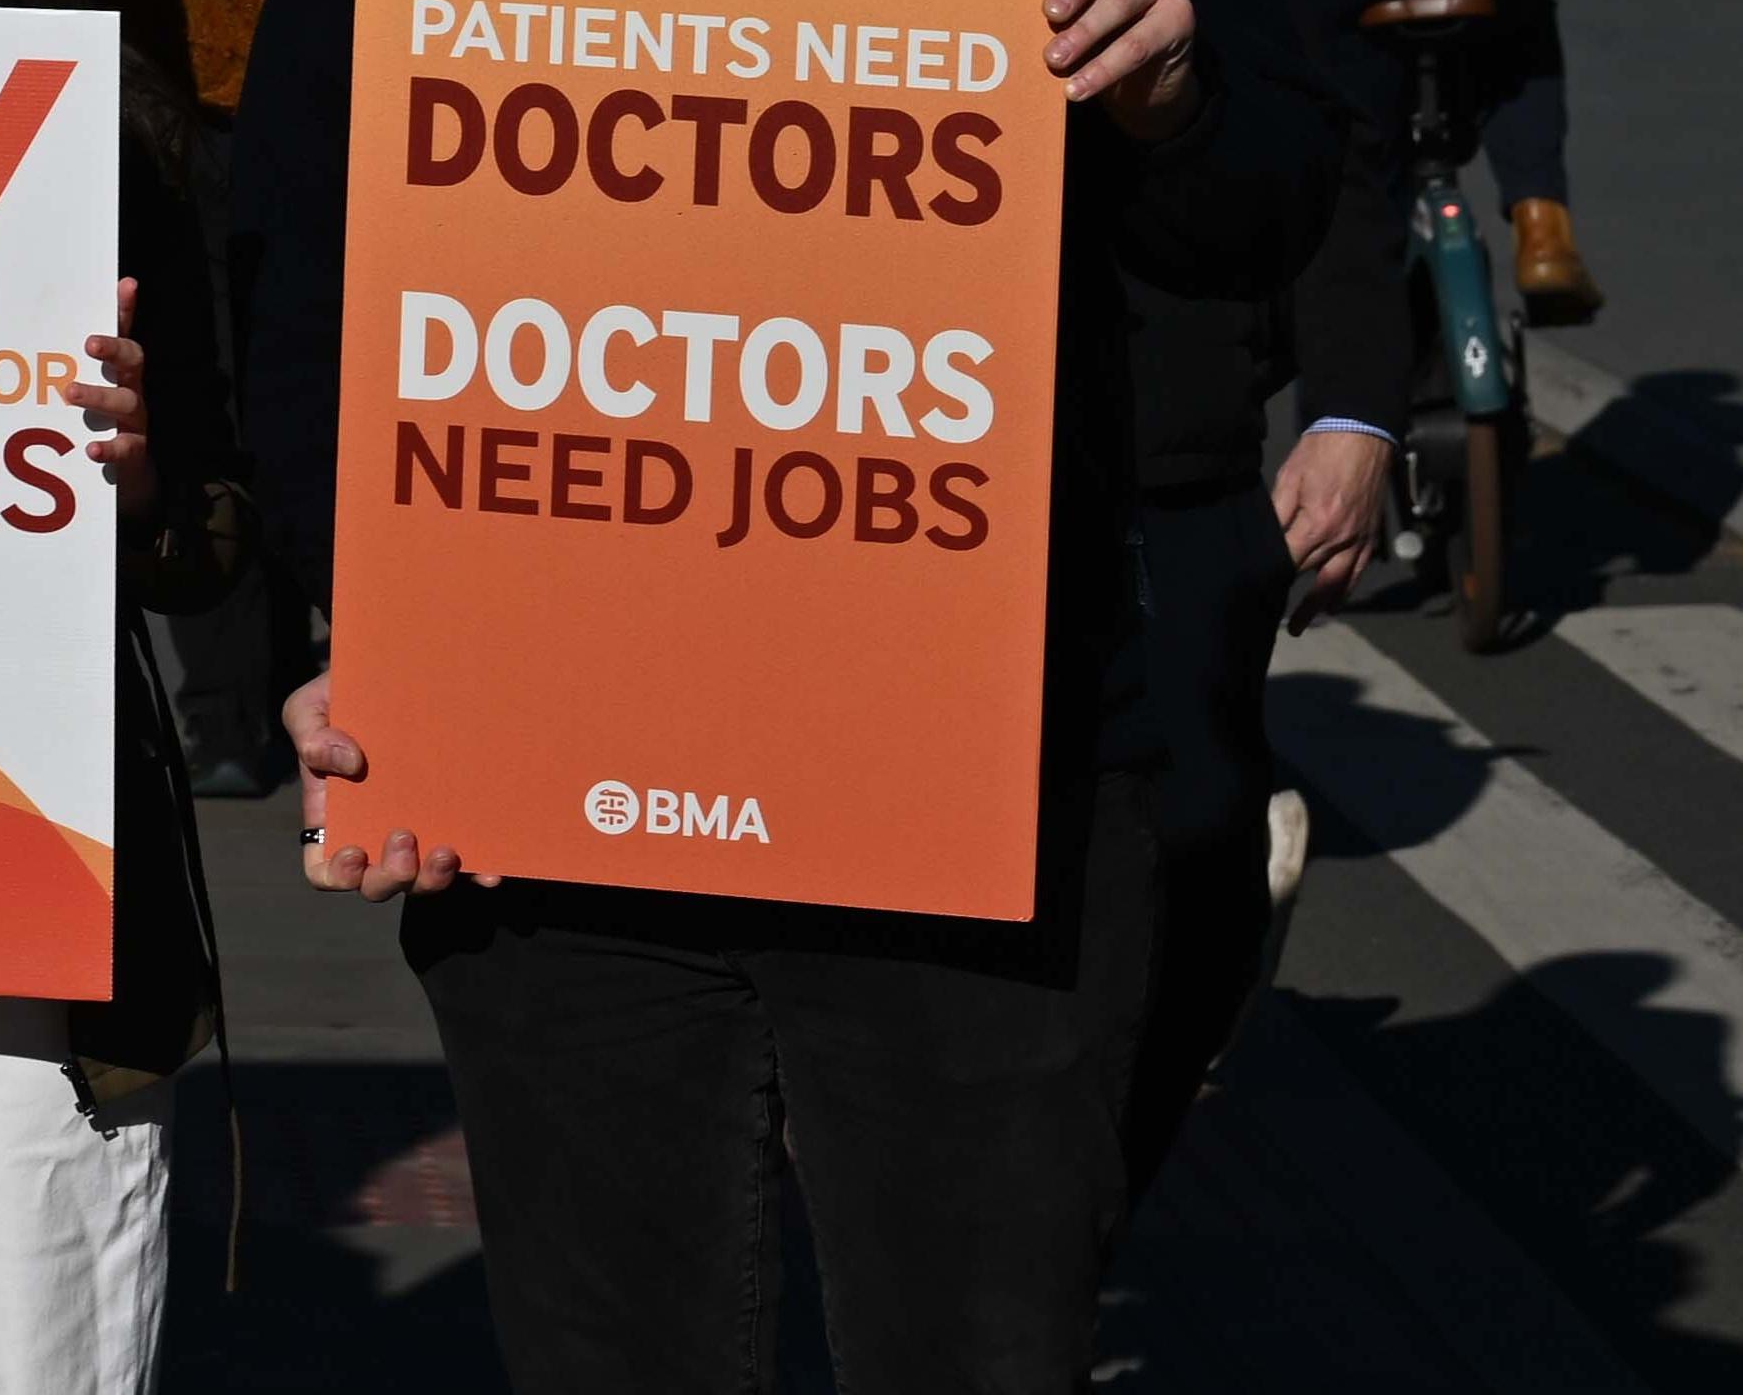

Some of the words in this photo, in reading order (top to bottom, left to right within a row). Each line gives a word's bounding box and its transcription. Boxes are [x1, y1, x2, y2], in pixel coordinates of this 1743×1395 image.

[794, 21, 1008, 94] NEED
[406, 76, 1004, 227] DOCTORS
[397, 291, 996, 445] DOCTORS
[392, 419, 696, 526] NEED
[714, 445, 991, 552] JOBS
[646, 788, 770, 845] BMA
